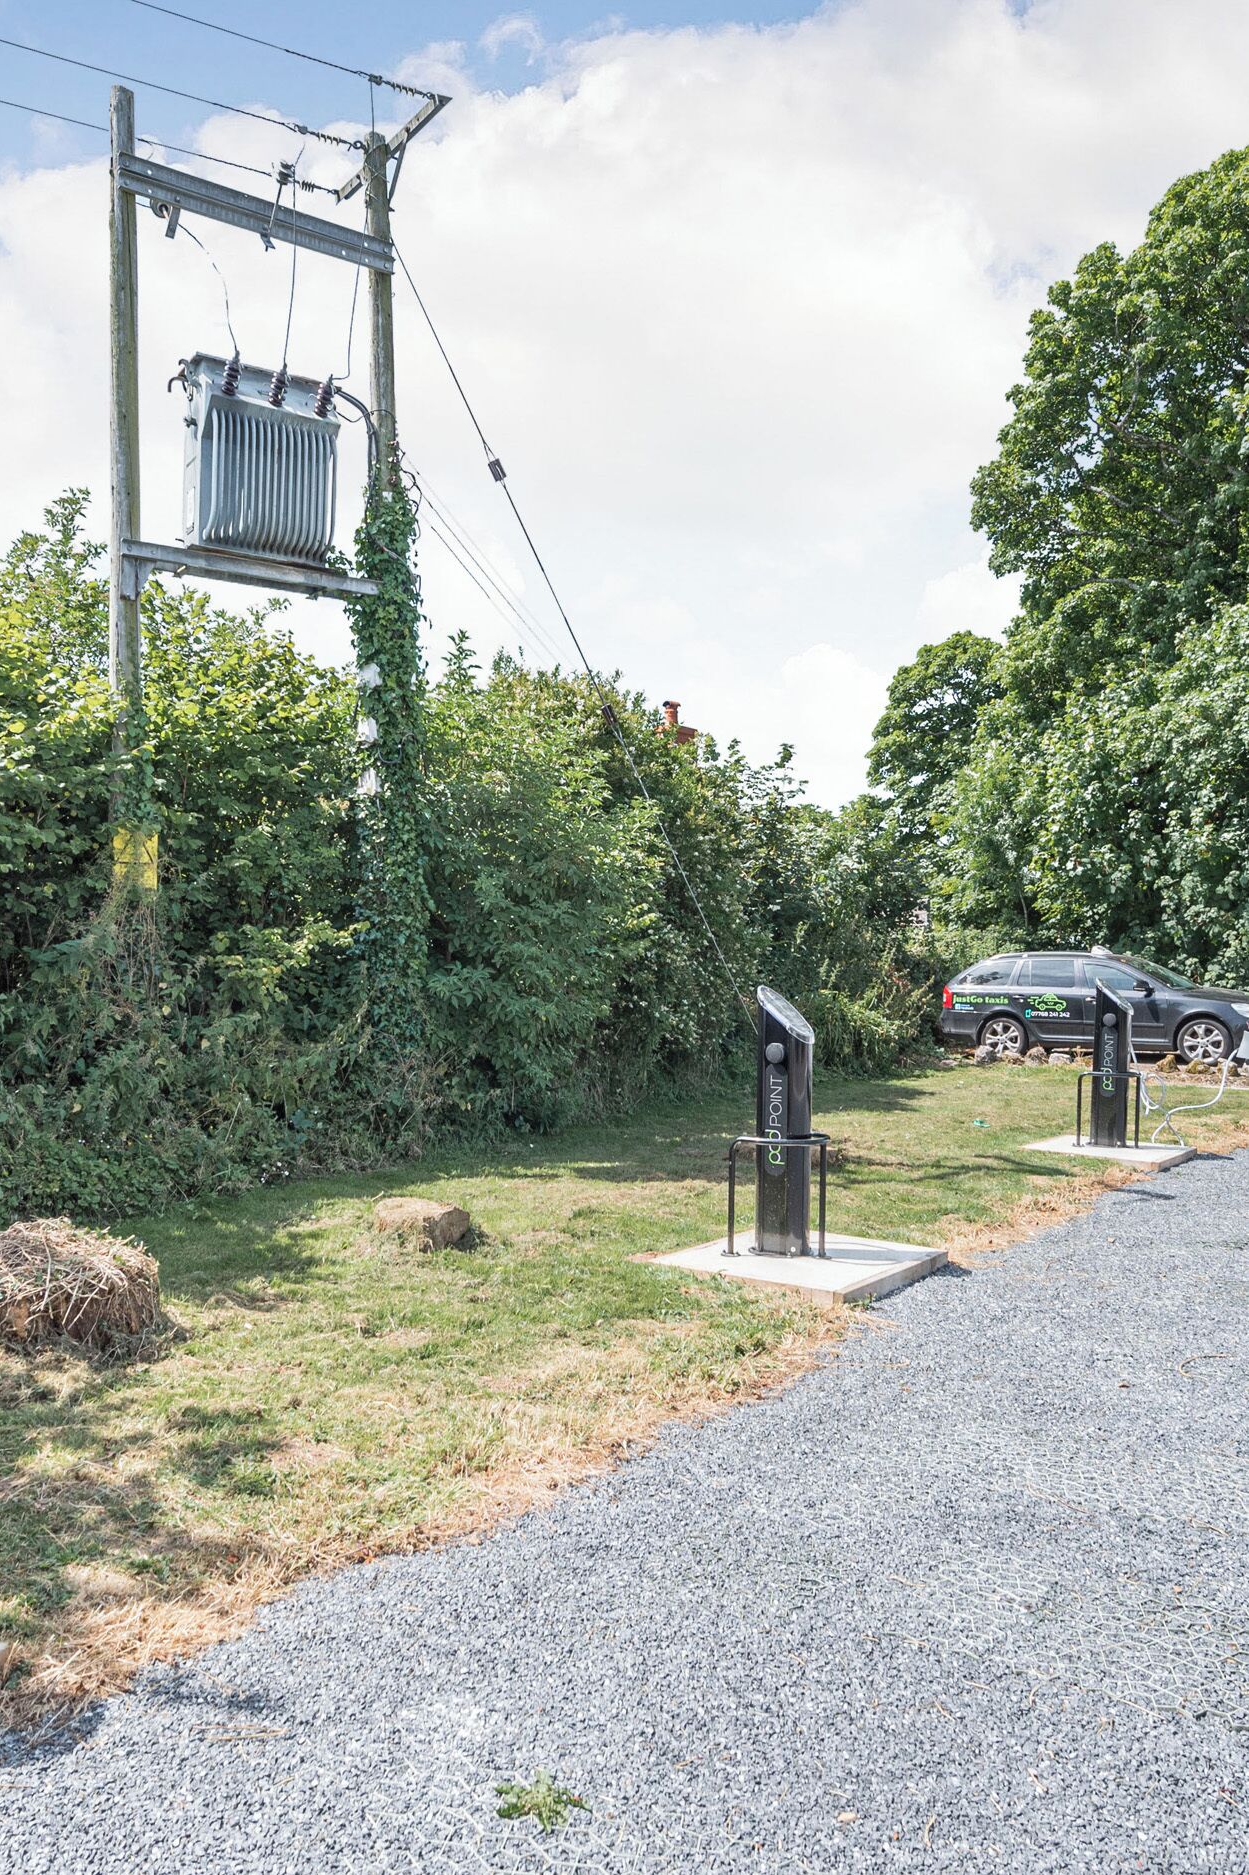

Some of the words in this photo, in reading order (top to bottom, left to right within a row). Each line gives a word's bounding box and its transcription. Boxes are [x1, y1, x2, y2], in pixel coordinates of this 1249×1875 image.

[984, 996, 1009, 1005] taxis
[1103, 1033, 1114, 1067] POINT
[769, 1075, 783, 1127] POINT
